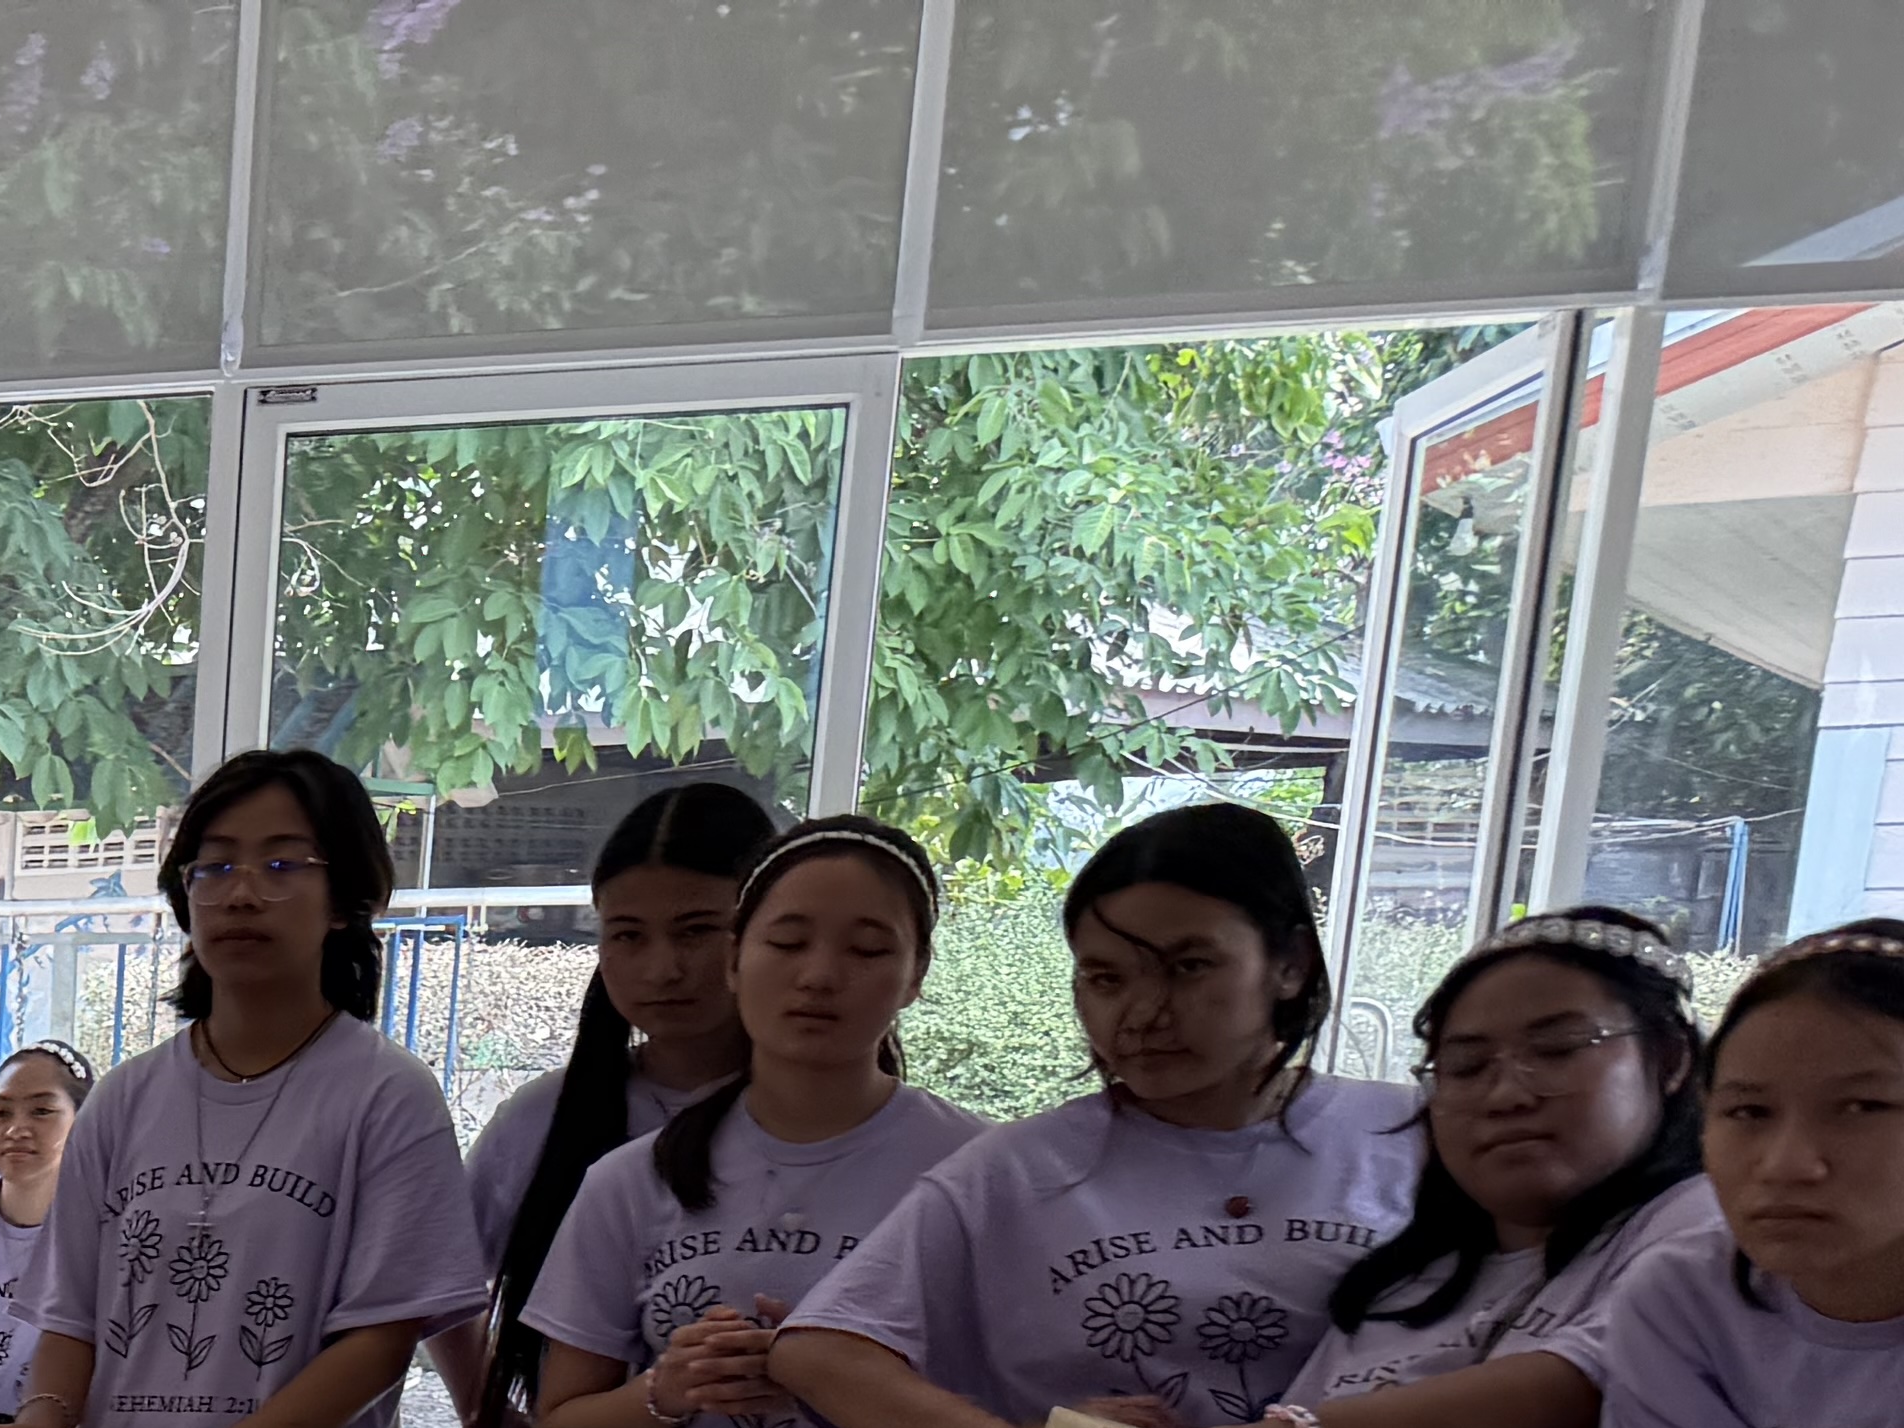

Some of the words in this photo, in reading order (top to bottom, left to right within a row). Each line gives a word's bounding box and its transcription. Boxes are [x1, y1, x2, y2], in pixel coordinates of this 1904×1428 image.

[176, 1161, 240, 1187] AND
[249, 1163, 337, 1220] BUILD
[736, 1226, 820, 1256] AND
[1050, 1231, 1158, 1294] ARISE
[1172, 1223, 1265, 1250] AND
[1285, 1218, 1377, 1248] BUIL
[114, 1395, 213, 1413] EHEMIAH
[228, 1396, 257, 1413] 2:1
